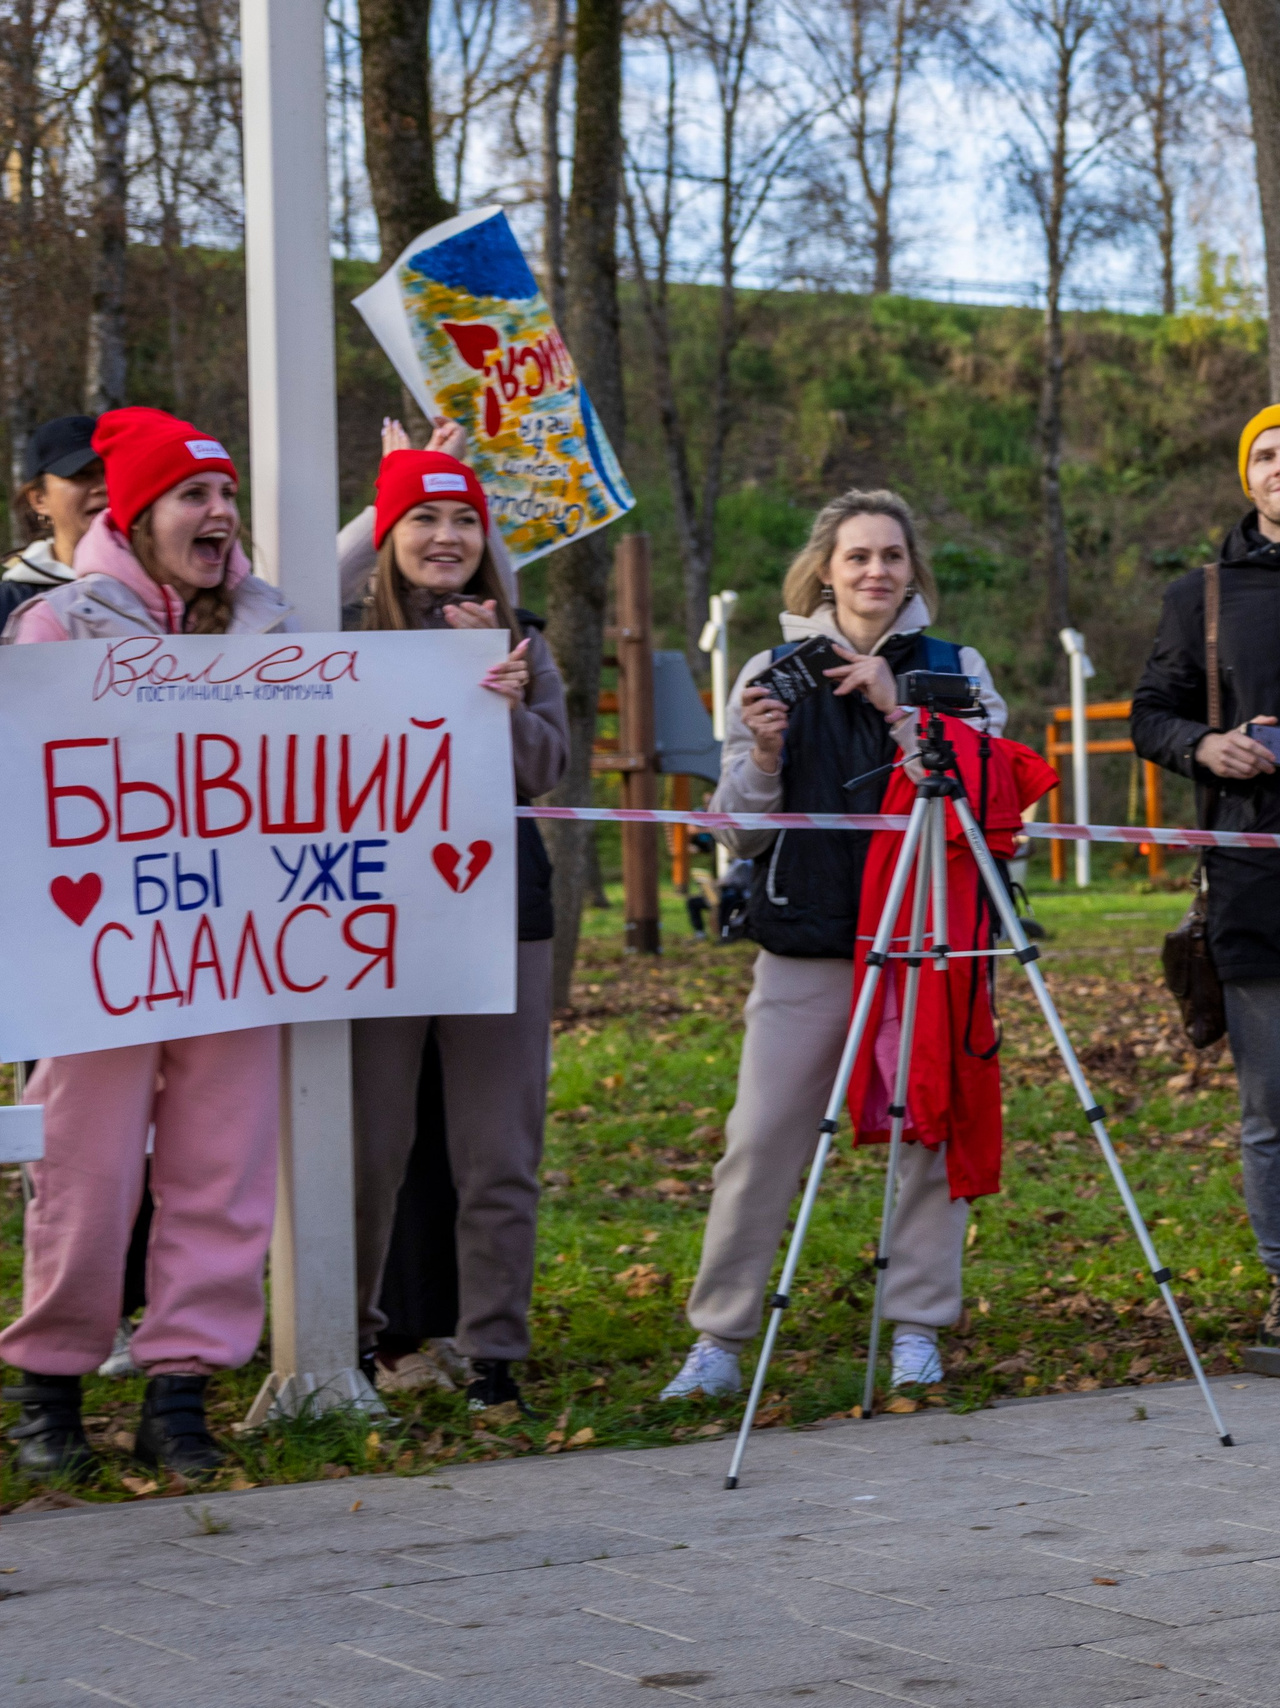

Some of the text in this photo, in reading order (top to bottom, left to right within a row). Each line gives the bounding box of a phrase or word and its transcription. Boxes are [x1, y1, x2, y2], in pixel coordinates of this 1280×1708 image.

[93, 636, 359, 701] Волга
[136, 684, 334, 702] ГОСТИНИЦА-КОММУНА
[43, 717, 451, 848] БЫВШИЙ
[134, 840, 389, 916] БЫ УЖЕ
[92, 903, 397, 1016] СДАЛСЯ
